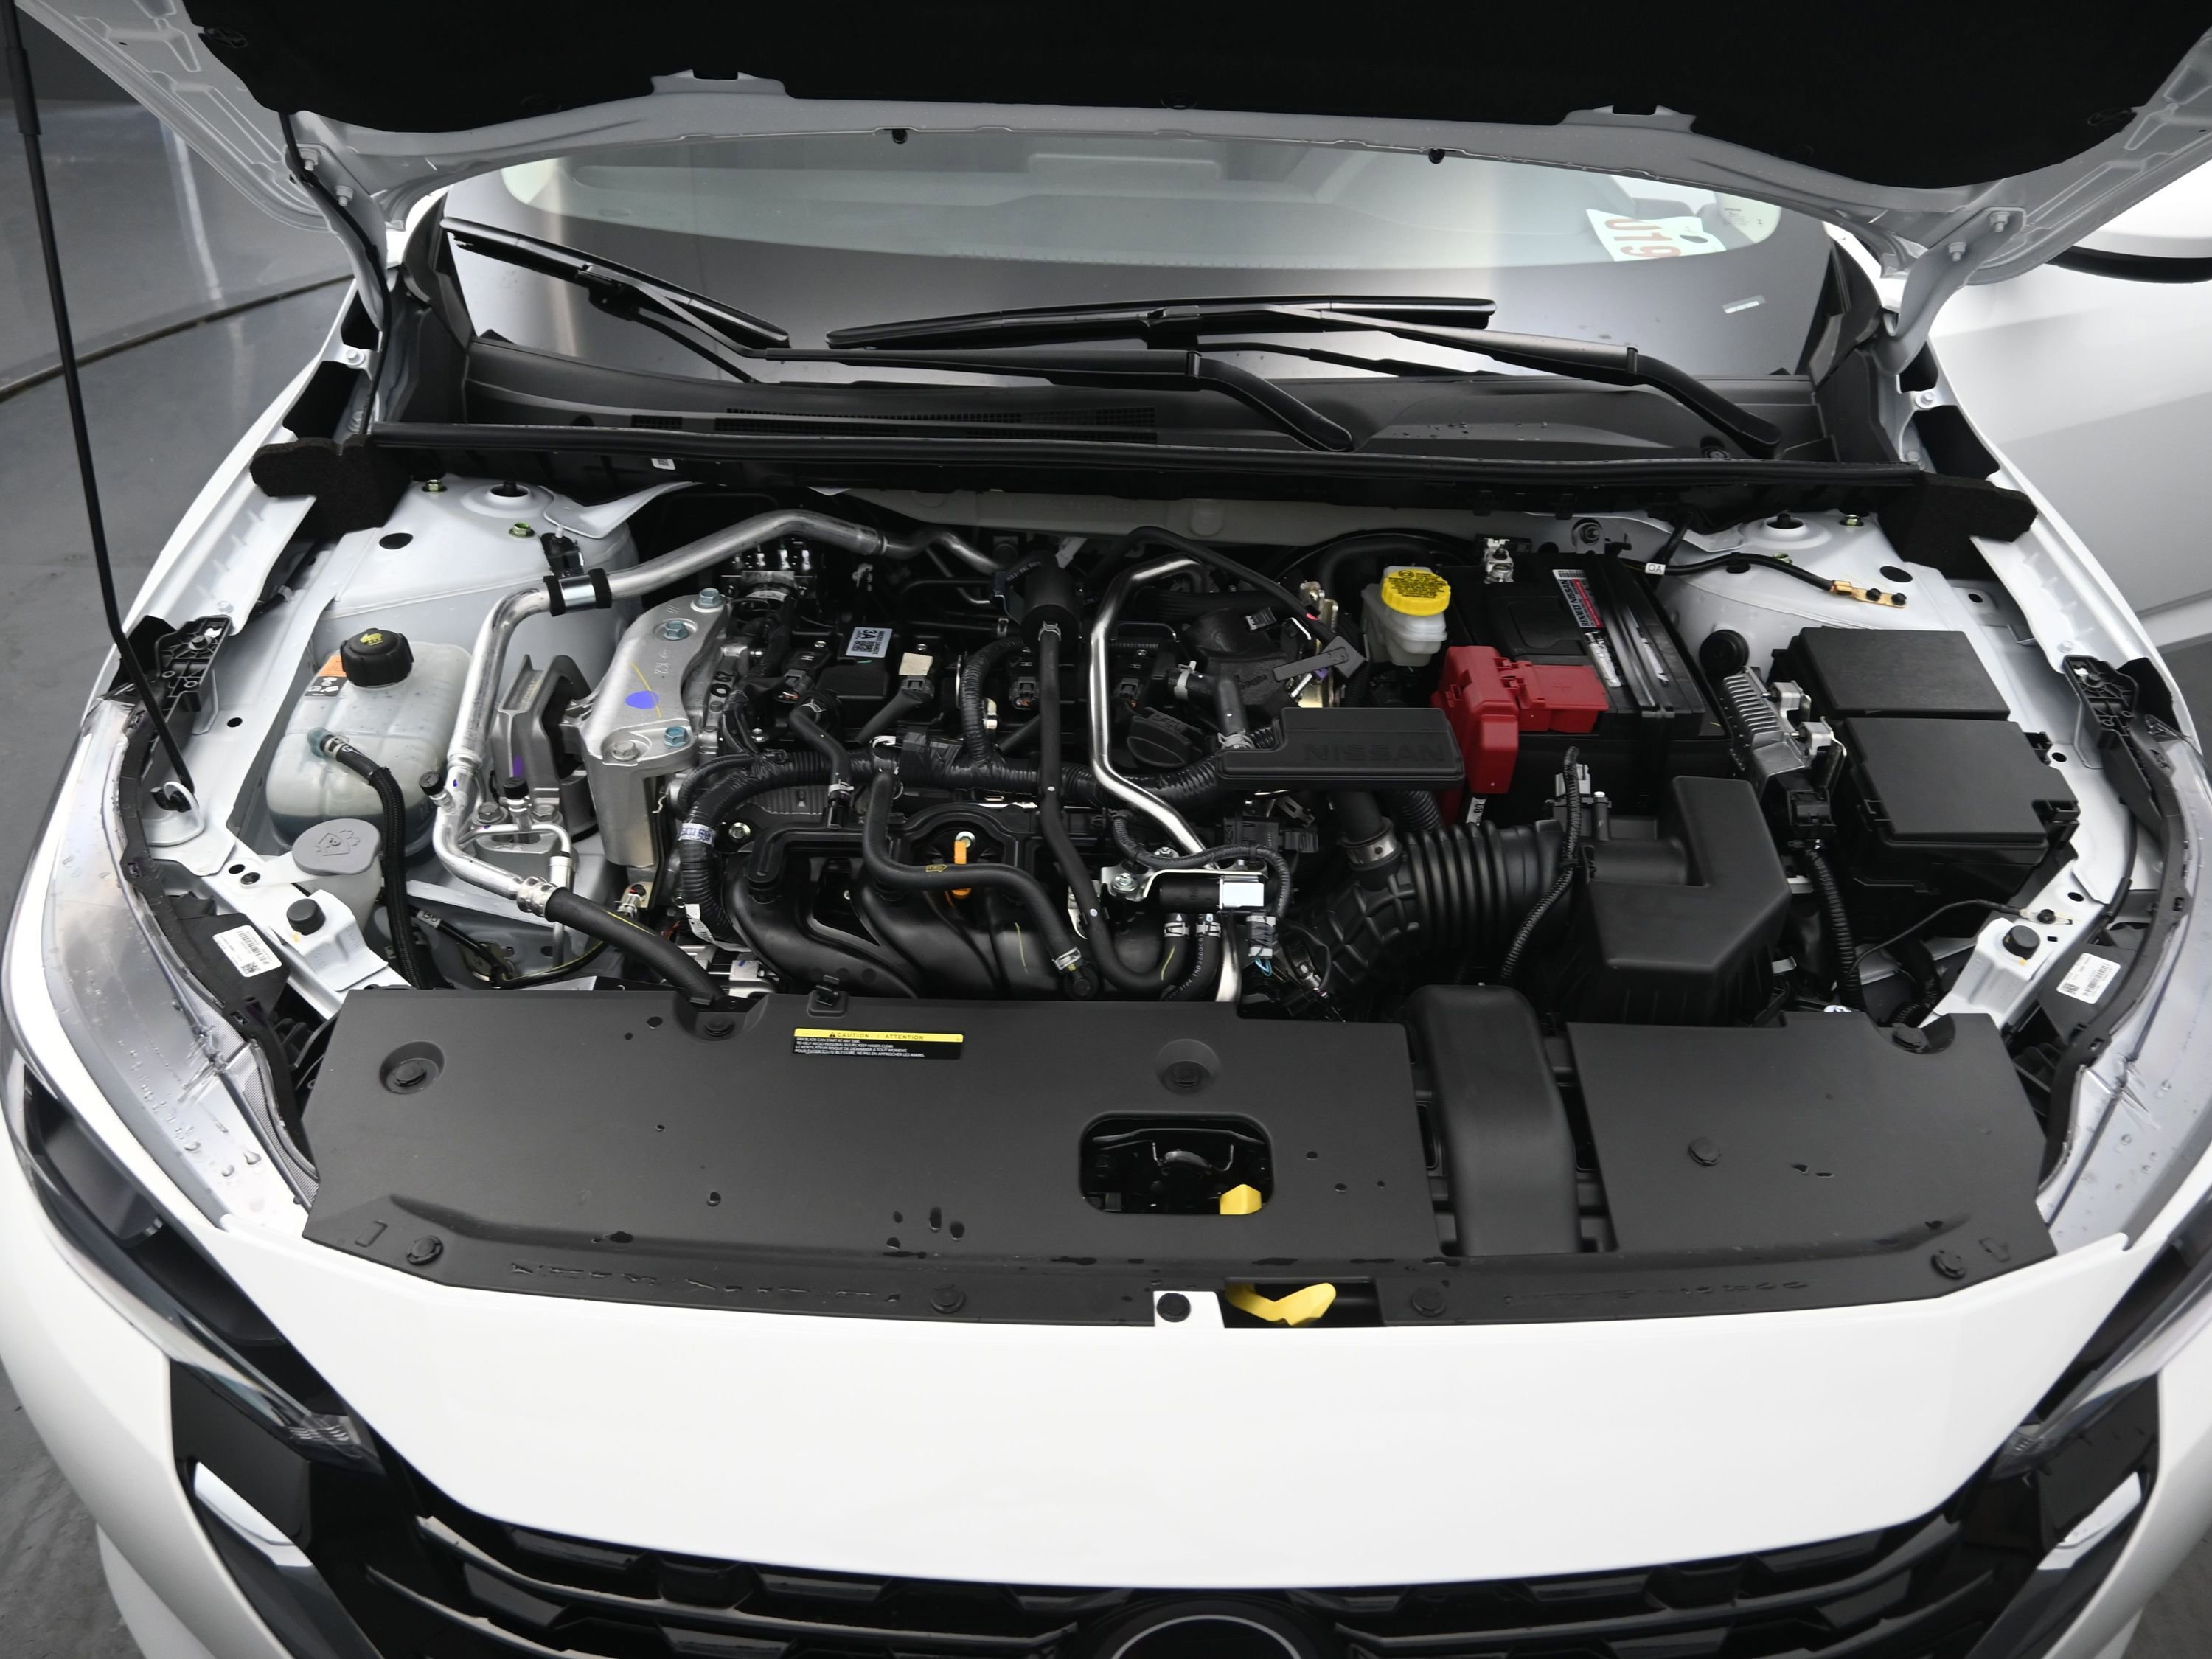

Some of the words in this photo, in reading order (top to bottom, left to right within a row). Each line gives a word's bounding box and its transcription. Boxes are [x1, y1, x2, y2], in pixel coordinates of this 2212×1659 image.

[1559, 580, 1578, 603] NISSAN
[1572, 604, 1589, 626] RENAULT
[862, 630, 877, 639] 3A
[1303, 743, 1445, 761] NISSAN
